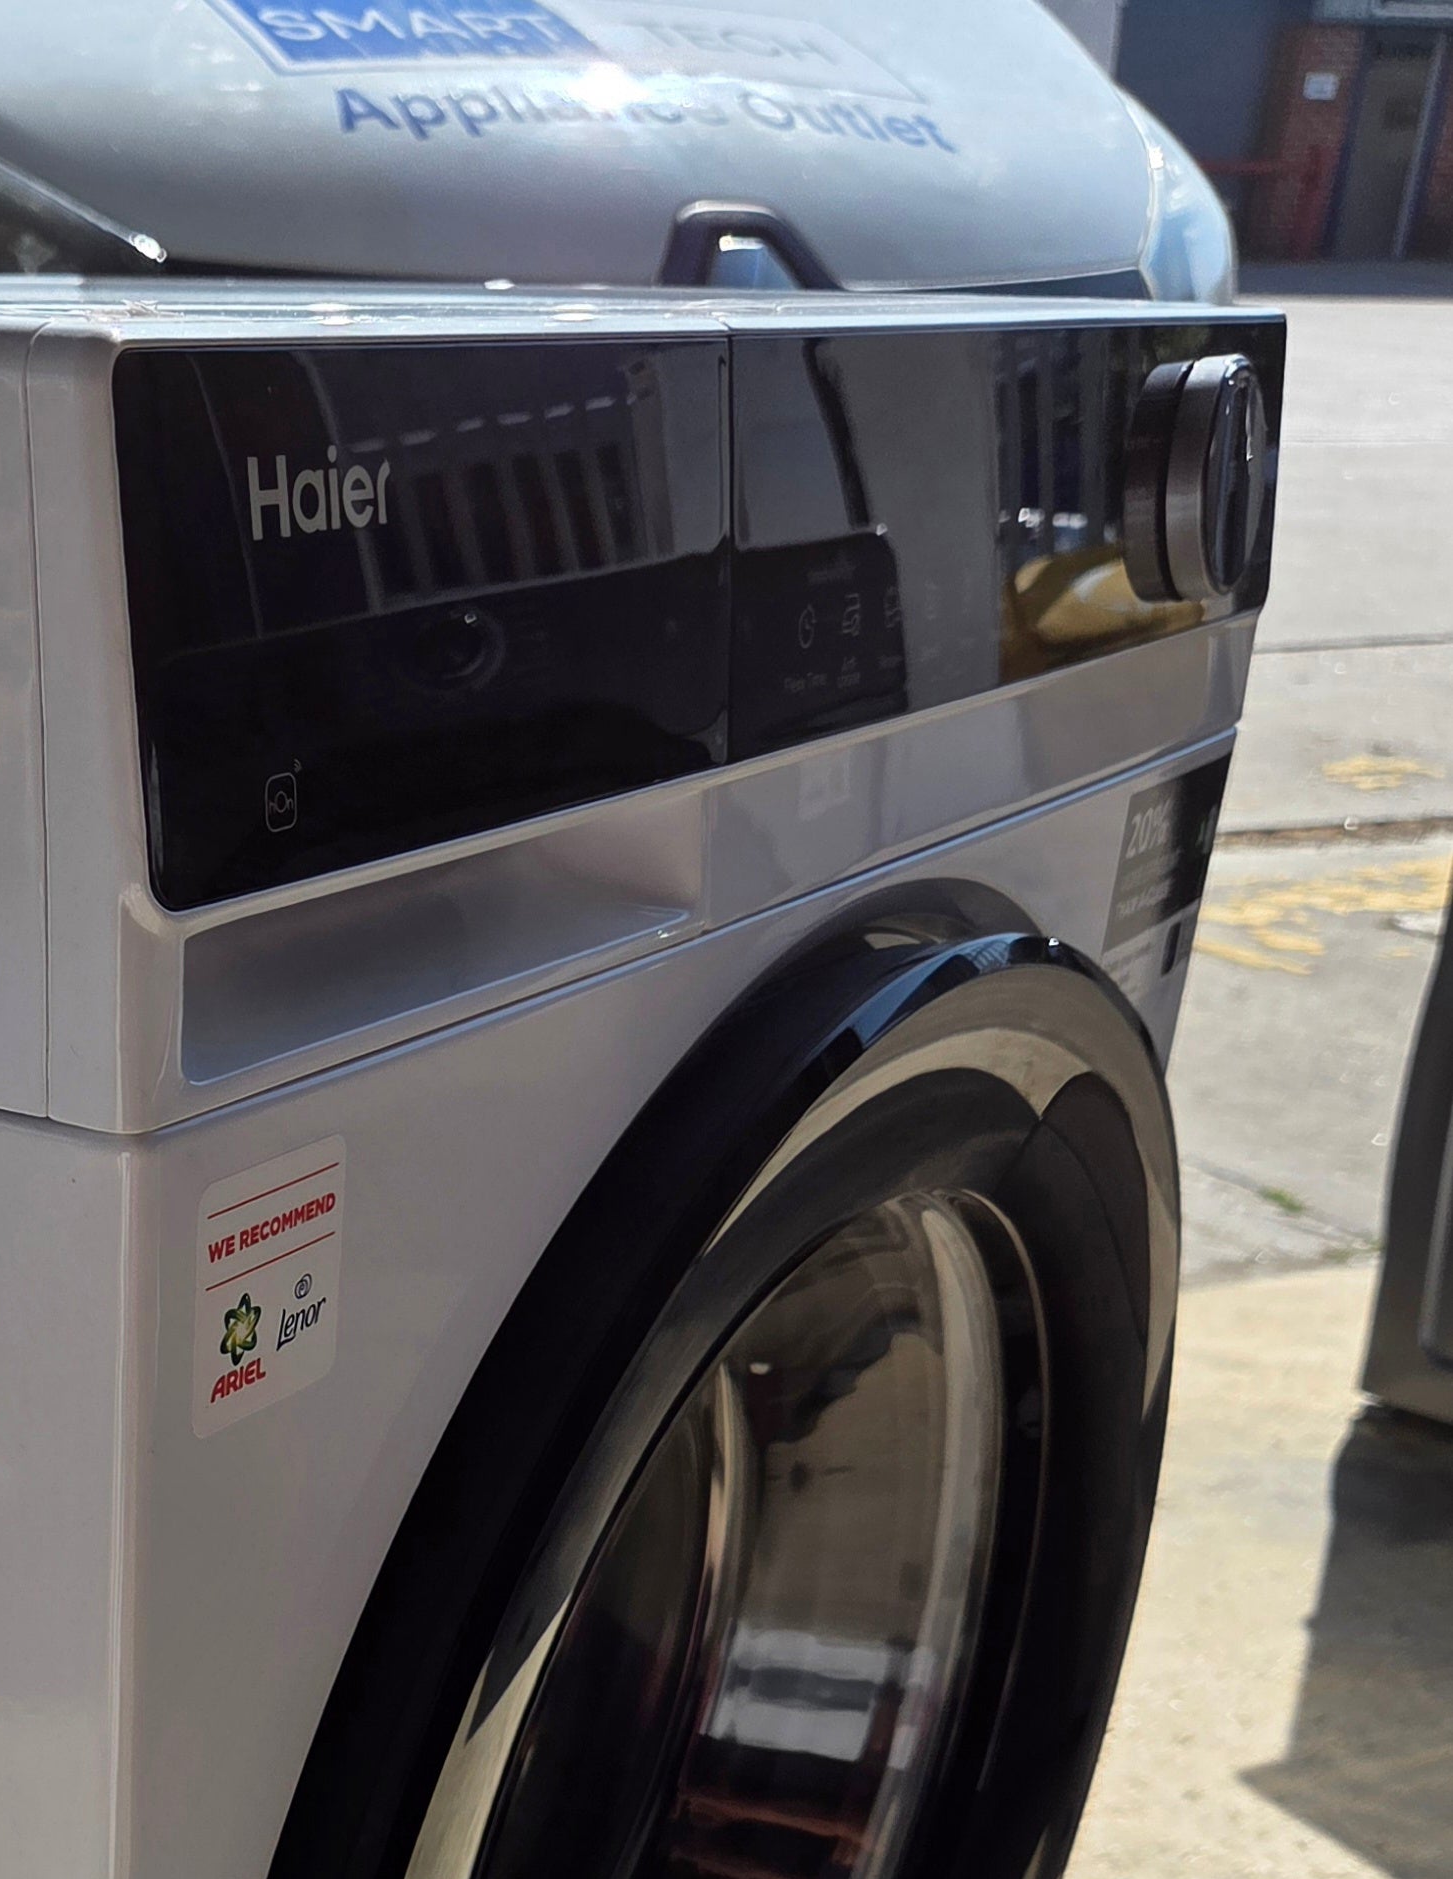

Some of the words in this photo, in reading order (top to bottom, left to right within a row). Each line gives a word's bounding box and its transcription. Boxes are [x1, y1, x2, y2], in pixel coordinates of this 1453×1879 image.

[258, 8, 563, 42] SMART
[737, 92, 960, 154] Outlet
[247, 445, 391, 541] Haier
[207, 1234, 237, 1263] WE
[239, 1192, 336, 1248] RECOMMEND
[276, 1297, 327, 1352] Lenor
[210, 1358, 267, 1404] ARIEL
